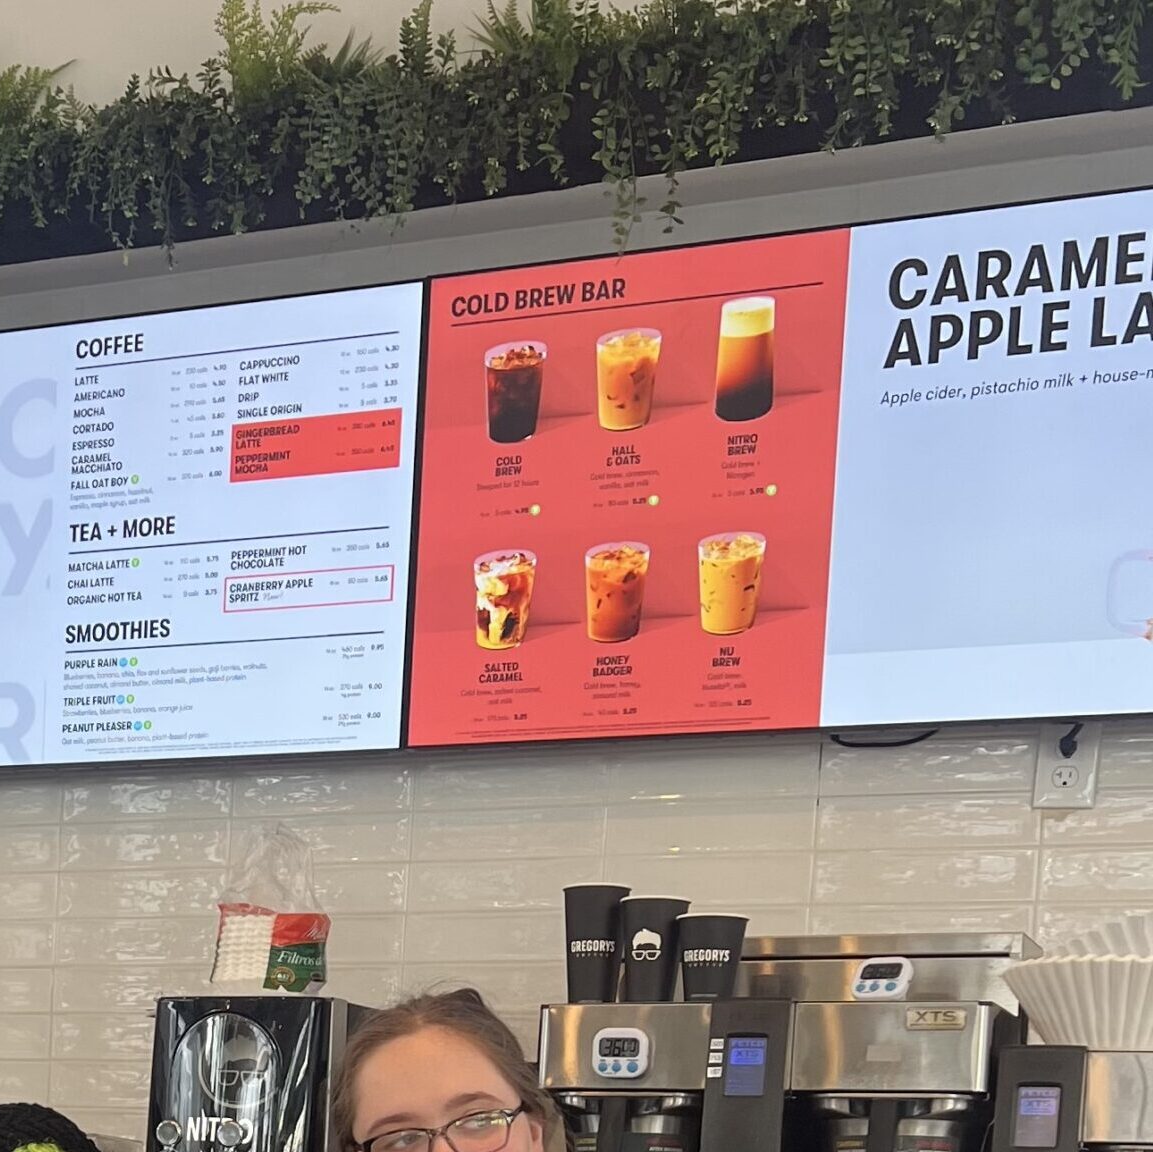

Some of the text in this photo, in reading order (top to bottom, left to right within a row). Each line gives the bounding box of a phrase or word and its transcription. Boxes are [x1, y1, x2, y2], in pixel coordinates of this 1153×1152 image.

[888, 231, 1153, 310] CARAME
[451, 278, 626, 318] COLD BREW BAR
[883, 300, 1070, 369] APPLE
[76, 333, 144, 359] COFFEE
[240, 355, 300, 371] CAPPUCCINO
[74, 375, 99, 386] LATTE
[239, 372, 289, 386] FLAT WHITE
[74, 388, 125, 402] AMERICANO
[880, 390, 922, 408] Apple
[925, 385, 967, 401] cider,
[970, 376, 1040, 400] pistachio
[1043, 373, 1073, 389] milk
[238, 392, 259, 403] DRIP
[73, 407, 105, 419] MOCHA
[237, 403, 302, 419] SINGLE ORIGIN
[73, 422, 114, 434] CORTADO
[236, 425, 300, 439] GINGERBREAD
[72, 438, 115, 451] ESPRESSO
[236, 439, 261, 450] LATTE
[728, 433, 758, 445] NITRO
[612, 445, 636, 456] HALL
[728, 444, 756, 456] BREW
[71, 453, 111, 465] CARAMEL
[235, 450, 291, 464] PEPPERMINT
[496, 455, 522, 467] COLD
[606, 455, 641, 467] & OATS
[71, 462, 123, 475] MACCHIATO
[235, 463, 268, 474] MOCHA
[495, 465, 522, 477] BREW
[71, 476, 129, 490] FALL OAT BOY
[70, 515, 176, 543] TEA + MORE
[231, 545, 307, 560] PEPPERMINT HOT
[68, 559, 130, 572] MATCHA LATTE
[230, 557, 285, 570] CHOCOLATE
[67, 577, 114, 590] CHAI LATTE
[229, 578, 313, 593] CRANBERRY APPLE
[67, 591, 142, 606] ORGANIC HOT TEA
[229, 592, 260, 604] SPRITZ
[65, 618, 171, 644] SMOOTHIES
[720, 646, 735, 656] NU
[64, 658, 118, 670] PURPLE RAIN
[484, 662, 519, 673] SALTED
[596, 655, 630, 667] HONEY
[712, 656, 741, 667] BREW
[478, 672, 523, 683] CARAMEL
[592, 666, 633, 677] BADGER
[63, 695, 116, 706] TRIPLE FRUIT
[62, 721, 133, 733] PEANUT PLEASER
[570, 939, 615, 953] GREGORYS
[277, 950, 315, 966] Filtros
[683, 949, 730, 962] GREGORYS
[916, 1010, 957, 1022] XTS
[187, 1116, 253, 1145] NITO
